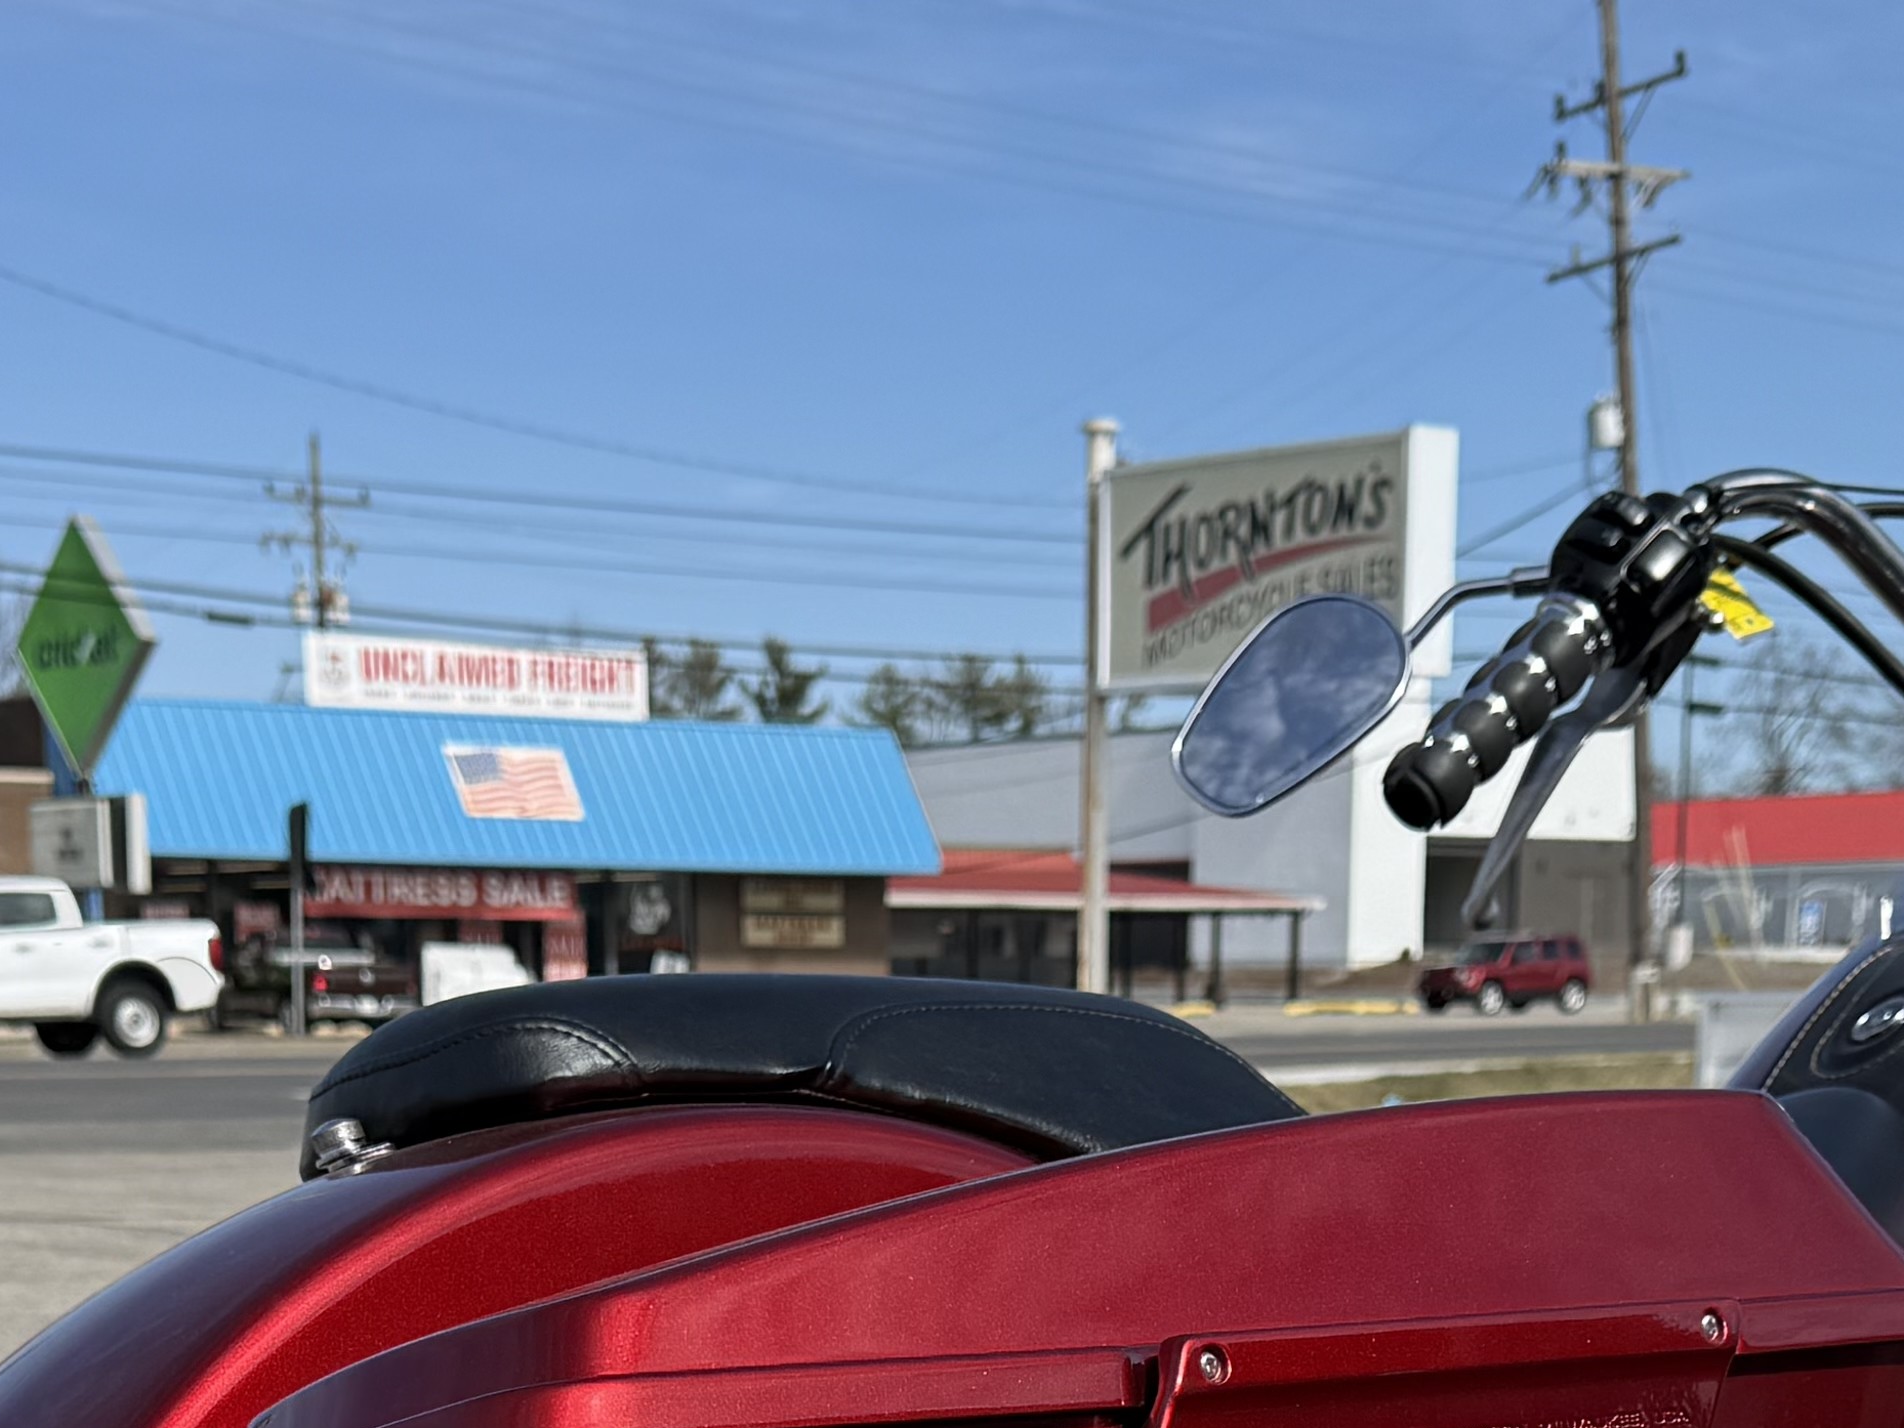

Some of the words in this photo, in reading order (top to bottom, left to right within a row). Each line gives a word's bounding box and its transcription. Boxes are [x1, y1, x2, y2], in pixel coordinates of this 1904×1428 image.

[1118, 462, 1394, 602] THORNTON'S
[361, 647, 520, 688] UNCLAIMED
[528, 657, 636, 695] FREIGHT
[482, 874, 570, 909] SALE
